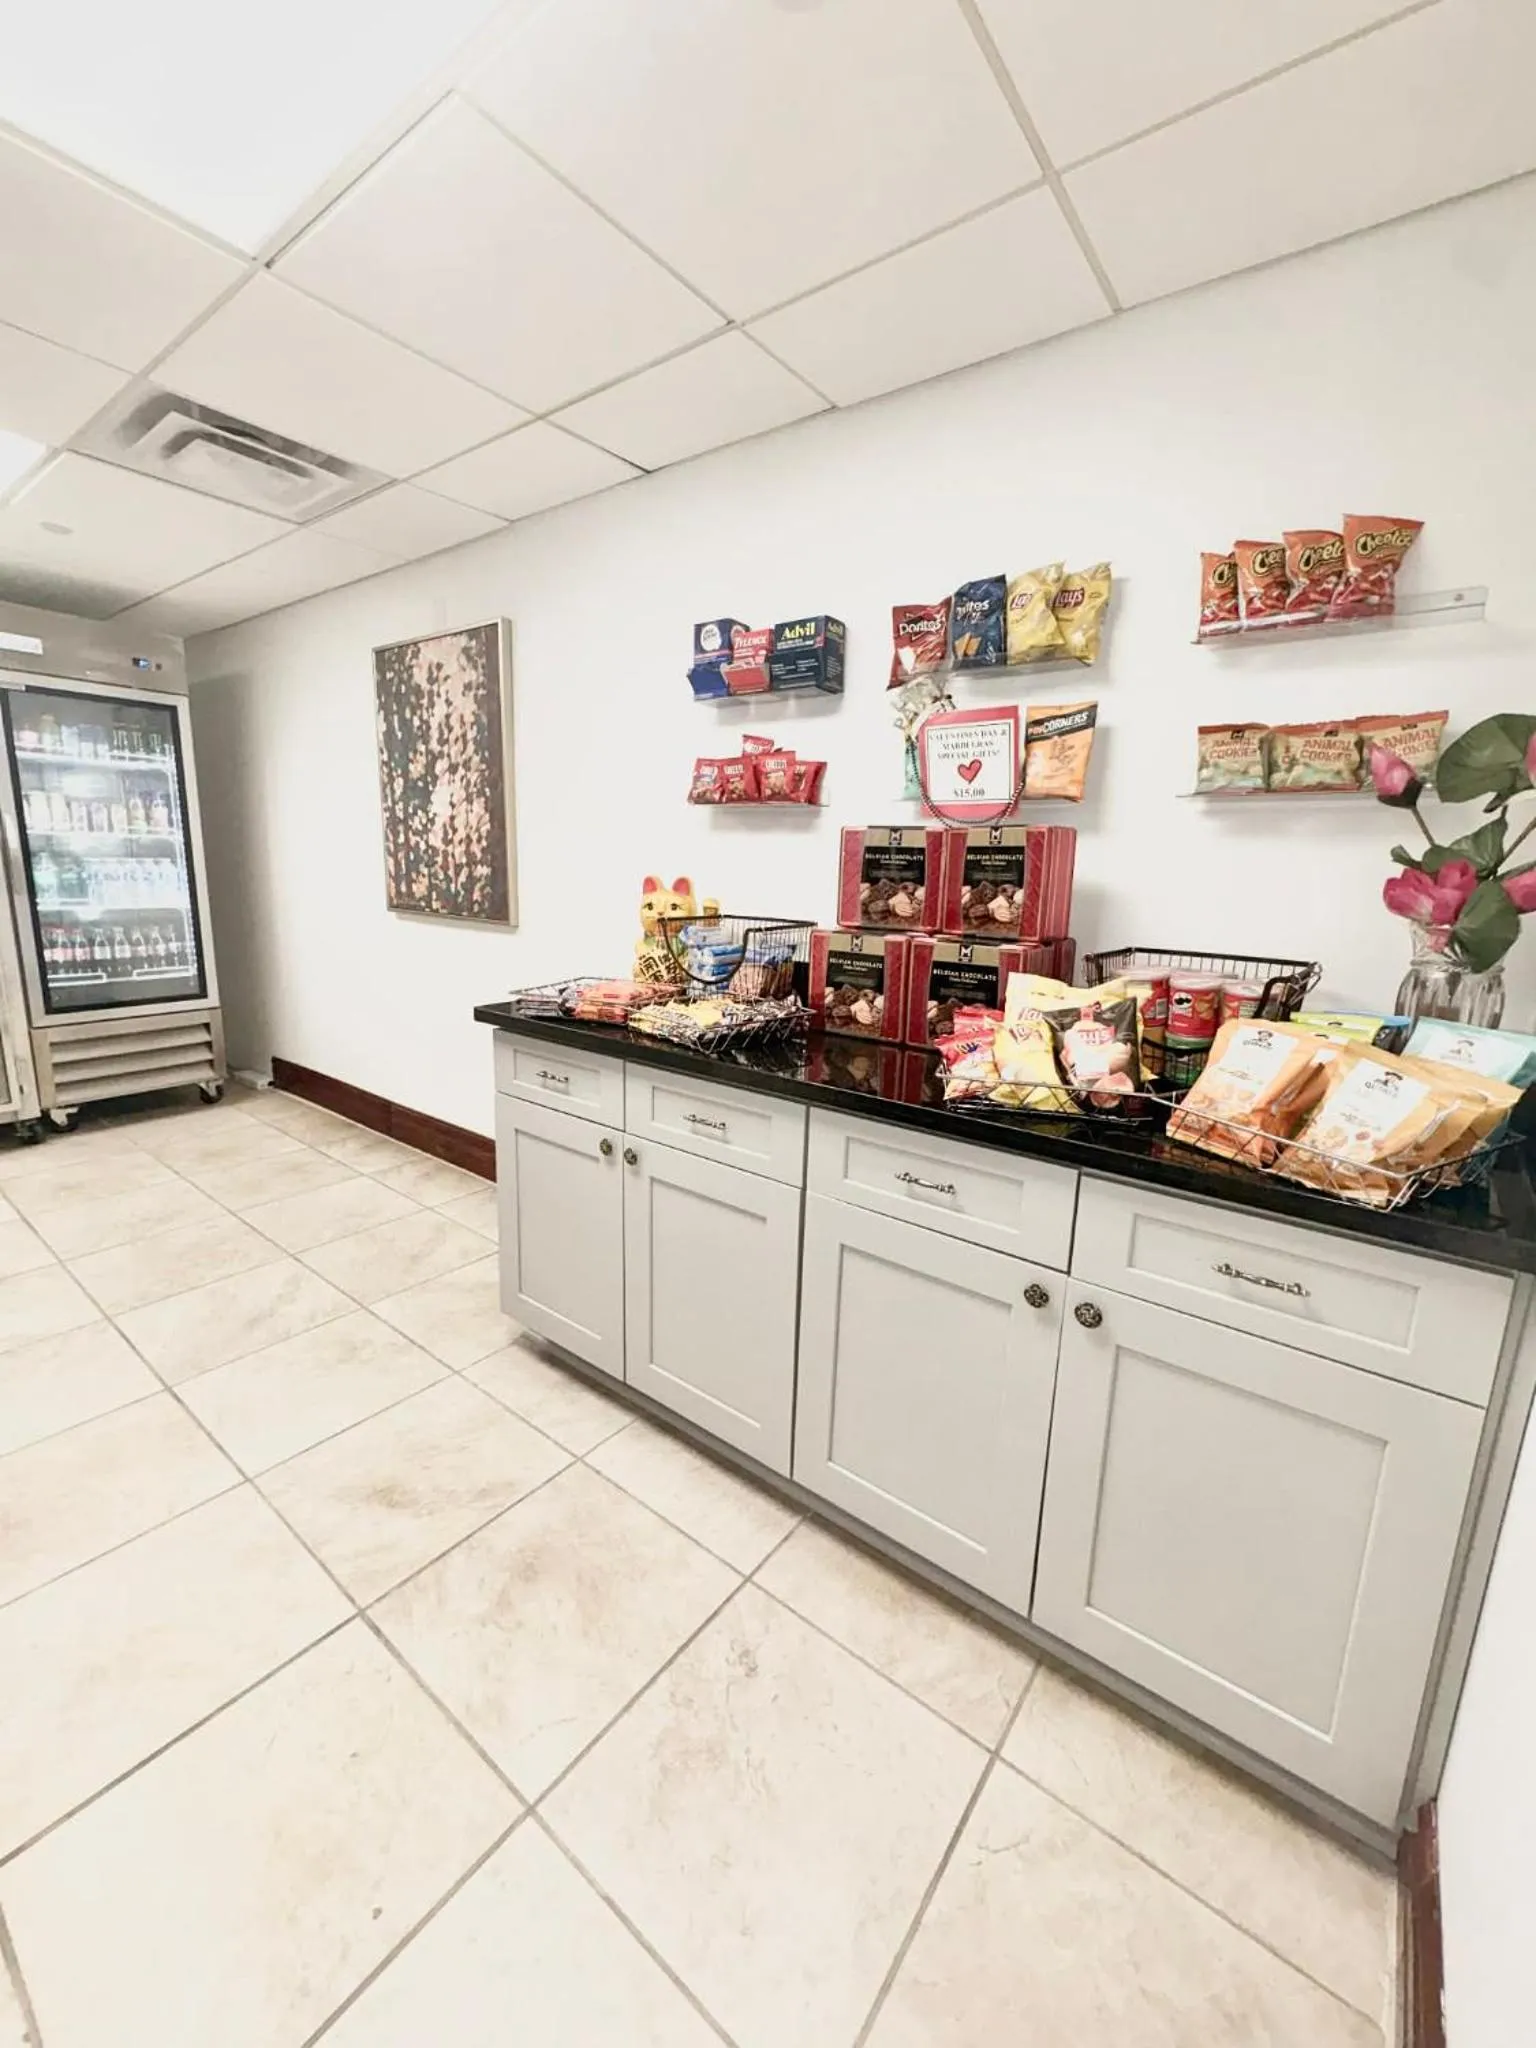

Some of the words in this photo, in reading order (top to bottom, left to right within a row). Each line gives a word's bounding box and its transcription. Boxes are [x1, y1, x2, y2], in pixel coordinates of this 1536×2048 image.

[781, 621, 816, 640] Advil
[898, 614, 946, 636] Doritos
[1212, 738, 1257, 749] ANIMAL
[1303, 738, 1354, 751] ANIMAL
[1383, 727, 1439, 748] ANIMAL
[1299, 748, 1353, 763] COOKIES
[960, 971, 997, 982] CHOCOLATE
